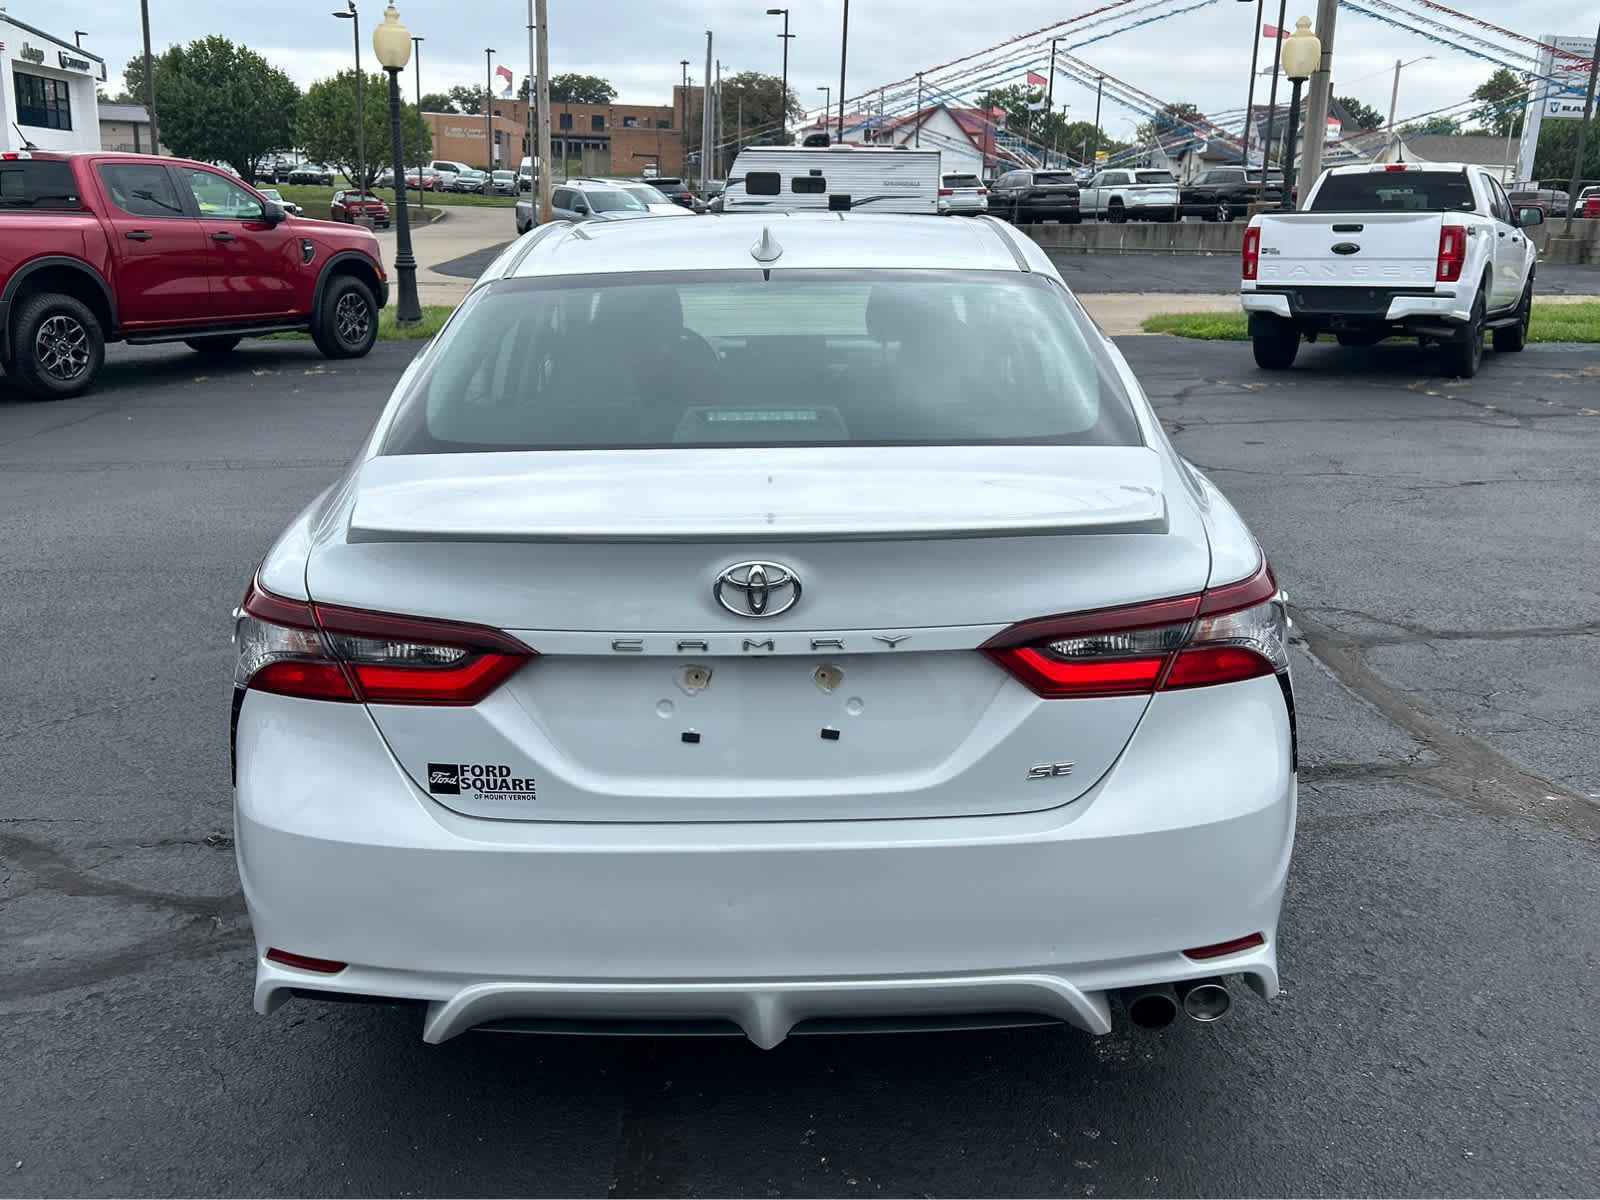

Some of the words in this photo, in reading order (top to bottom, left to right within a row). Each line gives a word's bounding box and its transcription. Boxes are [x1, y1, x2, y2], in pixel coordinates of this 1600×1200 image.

[1263, 264, 1432, 278] RANGER
[611, 634, 912, 652] CAMRY
[429, 771, 458, 785] Ford
[460, 764, 511, 778] FORD
[1027, 762, 1074, 780] SE
[460, 777, 536, 793] SQUARE
[484, 793, 508, 801] MOUNT
